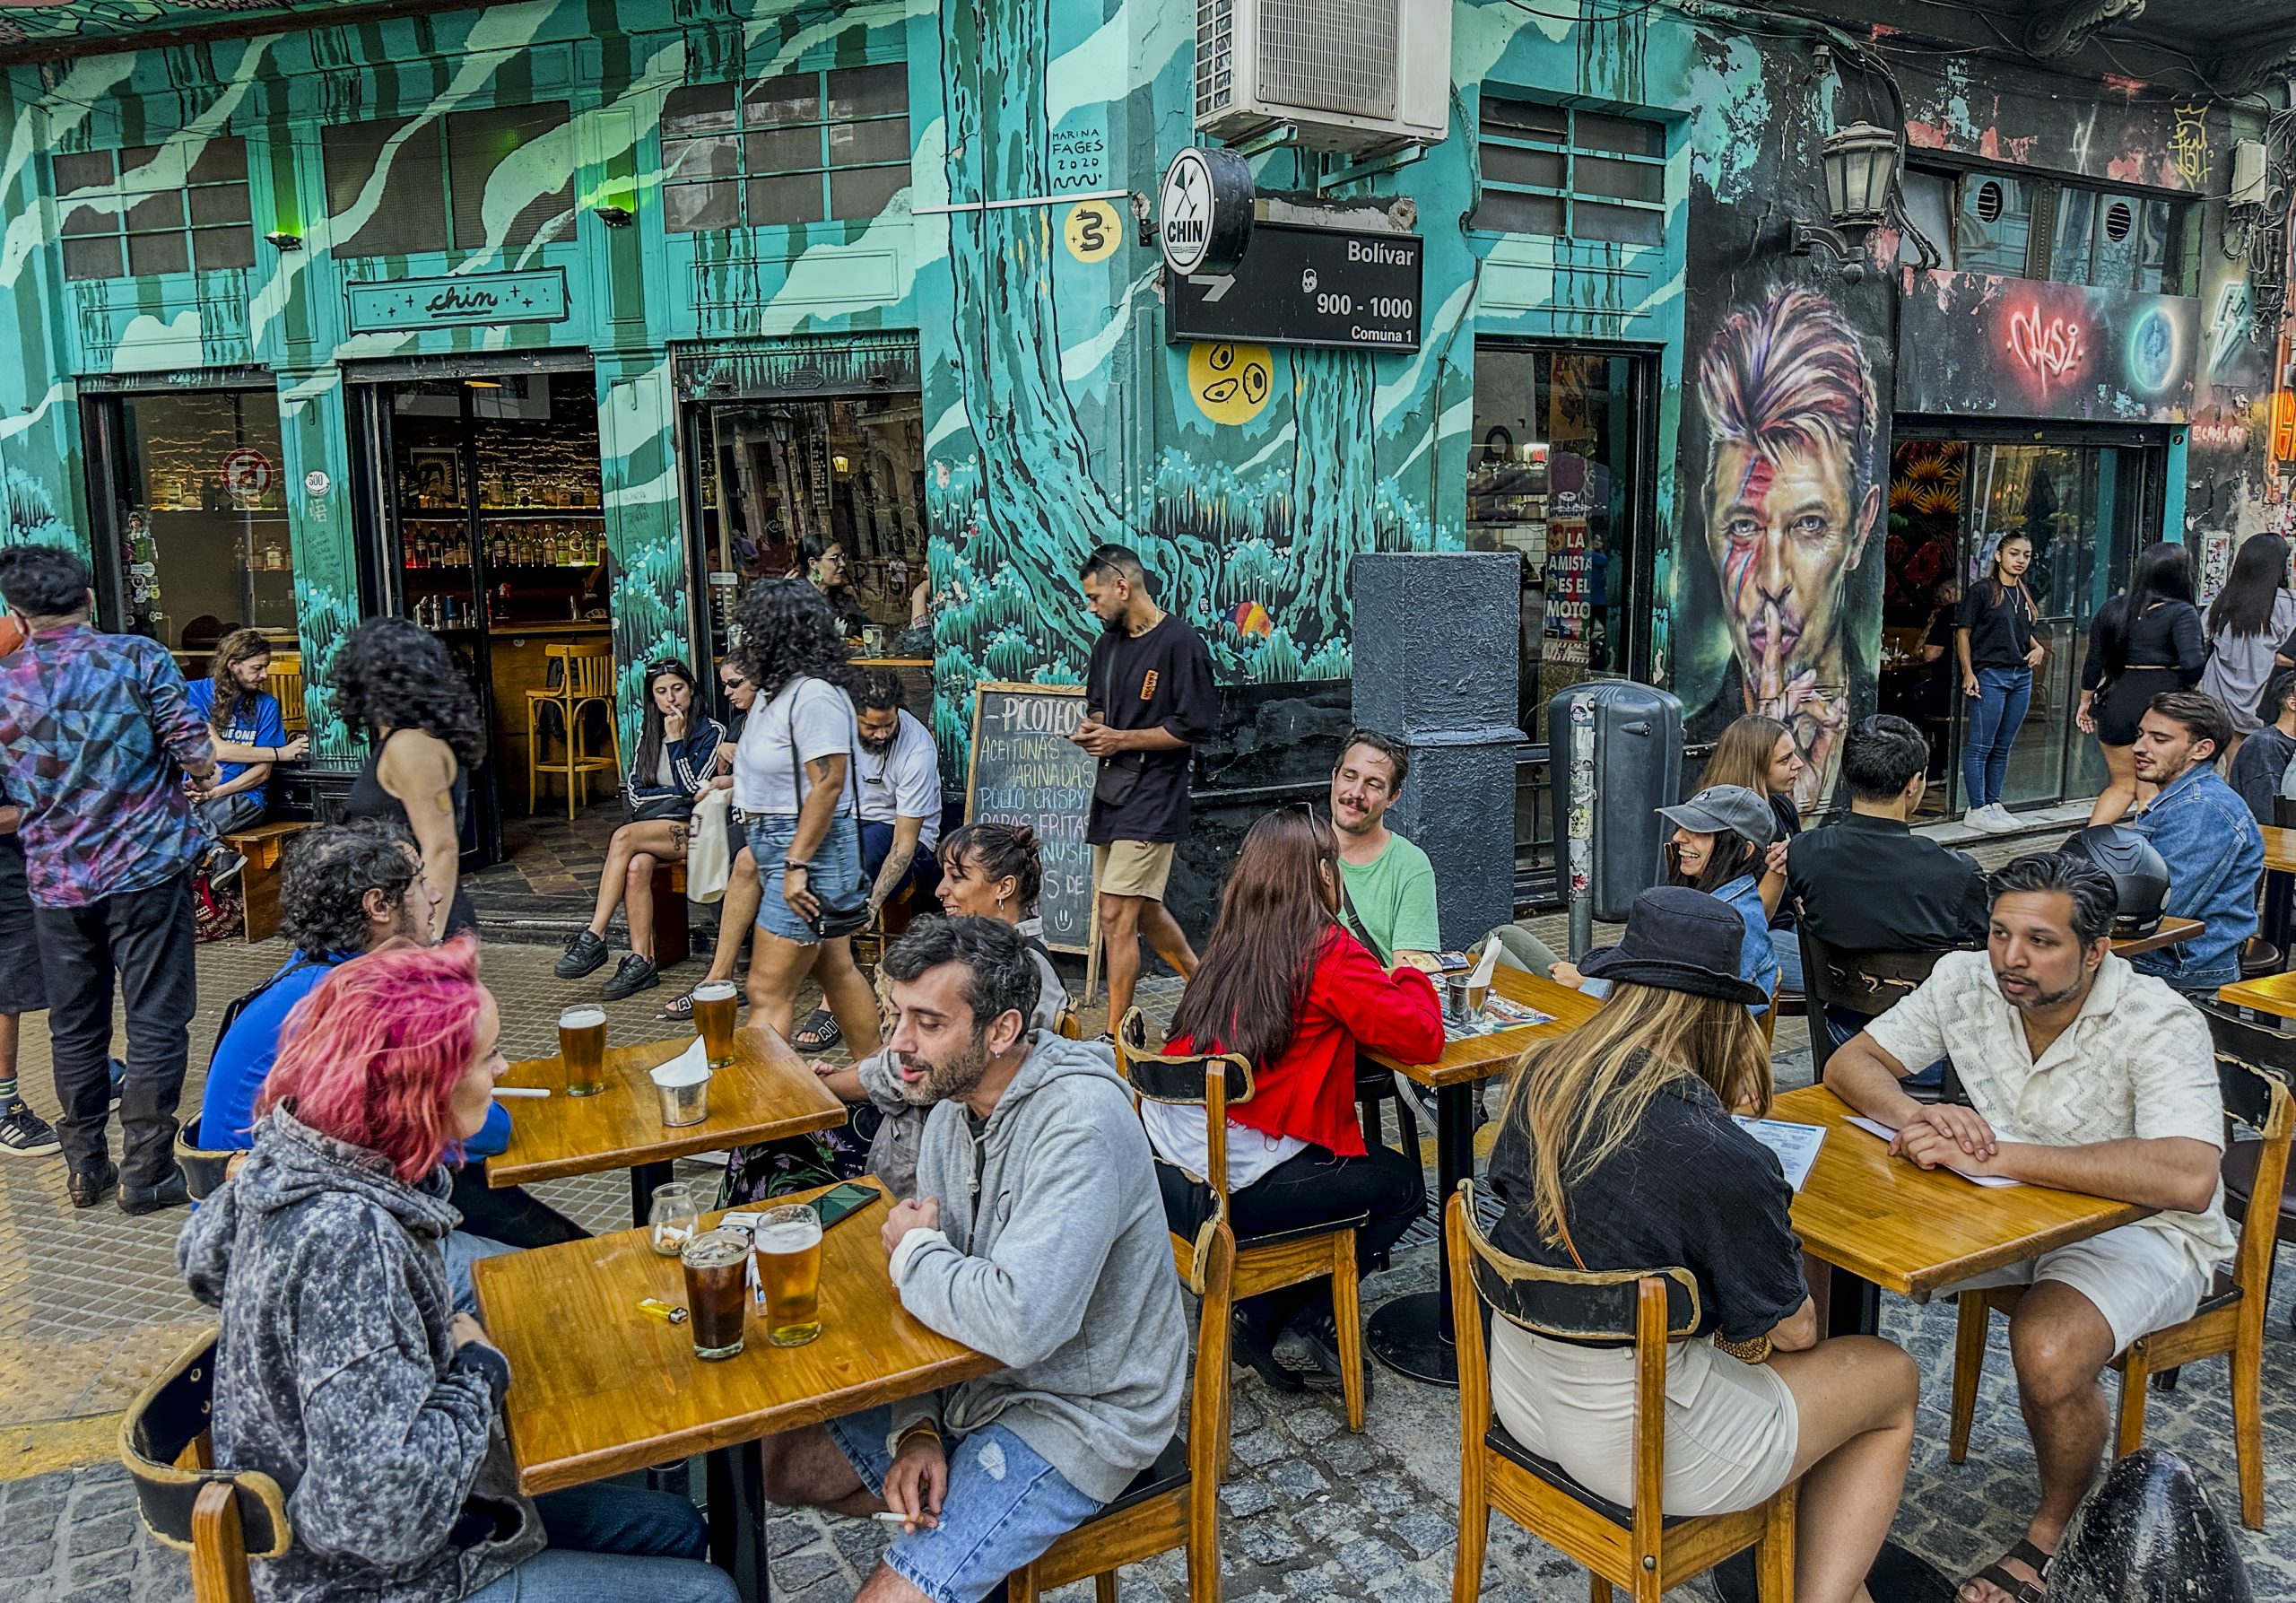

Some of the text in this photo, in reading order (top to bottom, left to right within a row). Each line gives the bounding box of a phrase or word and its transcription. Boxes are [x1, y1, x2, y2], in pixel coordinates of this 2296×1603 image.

[1053, 128, 1100, 141] MARINA
[1053, 139, 1104, 155] FAGES
[1167, 220, 1203, 243] CHIN
[1348, 240, 1414, 266] Bolívar
[425, 285, 499, 312] chin
[1317, 292, 1352, 316] 900
[1370, 296, 1413, 319] 1000
[1351, 325, 1413, 344] Comuna 1
[309, 474, 324, 486] 500
[1566, 532, 1586, 548] LA
[1558, 577, 1591, 594] ES EL
[1545, 599, 1591, 619] MOTO
[234, 729, 257, 741] ONE
[980, 735, 1060, 762] ACEITUNAS
[1004, 760, 1096, 788] MARINADAS
[978, 787, 1086, 810] POLLO CRISPY
